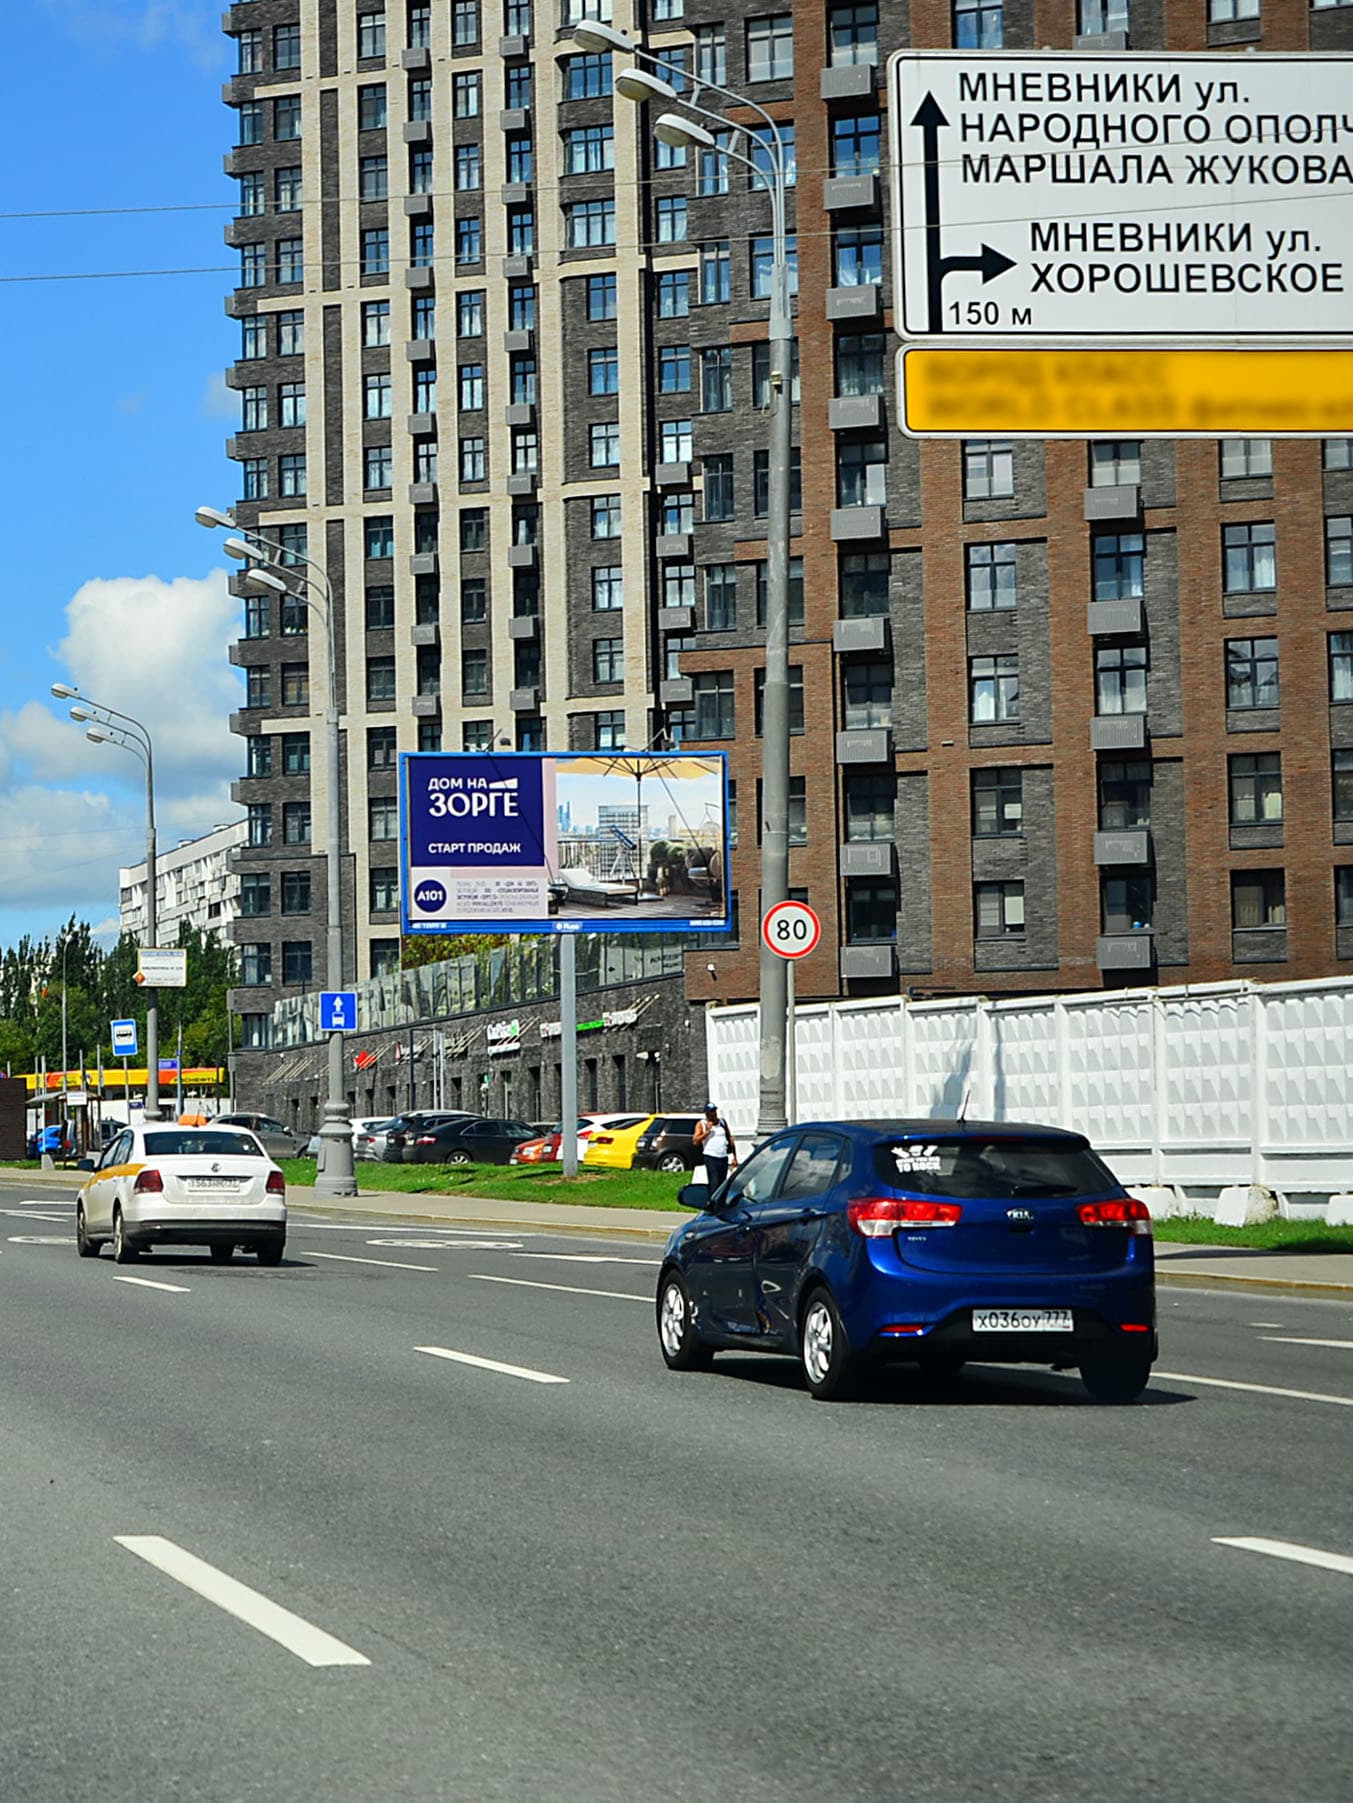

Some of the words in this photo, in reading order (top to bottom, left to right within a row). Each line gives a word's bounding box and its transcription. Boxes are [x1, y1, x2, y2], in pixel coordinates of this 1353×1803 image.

[959, 72, 1180, 103] МНЕВНИКИ
[1195, 81, 1249, 111] ул.
[961, 113, 1211, 149] НАРОДНОГО
[962, 153, 1173, 184] МАРШАЛА
[1186, 154, 1353, 185] ЖУКОВА
[1030, 221, 1252, 252] МНЕВНИКИ
[1266, 230, 1320, 260] ул.
[1030, 263, 1344, 293] ХОРОШЕВСКОЕ
[949, 301, 999, 325] 150
[1012, 307, 1032, 325] м
[428, 778, 463, 791] ДОМ
[467, 778, 488, 790] НА
[429, 792, 519, 817] ЗОРГЕ
[428, 843, 466, 854] СТАРТ
[467, 843, 521, 856] ПРОДАЖ
[777, 919, 807, 940] 80
[1012, 1209, 1030, 1219] KIA
